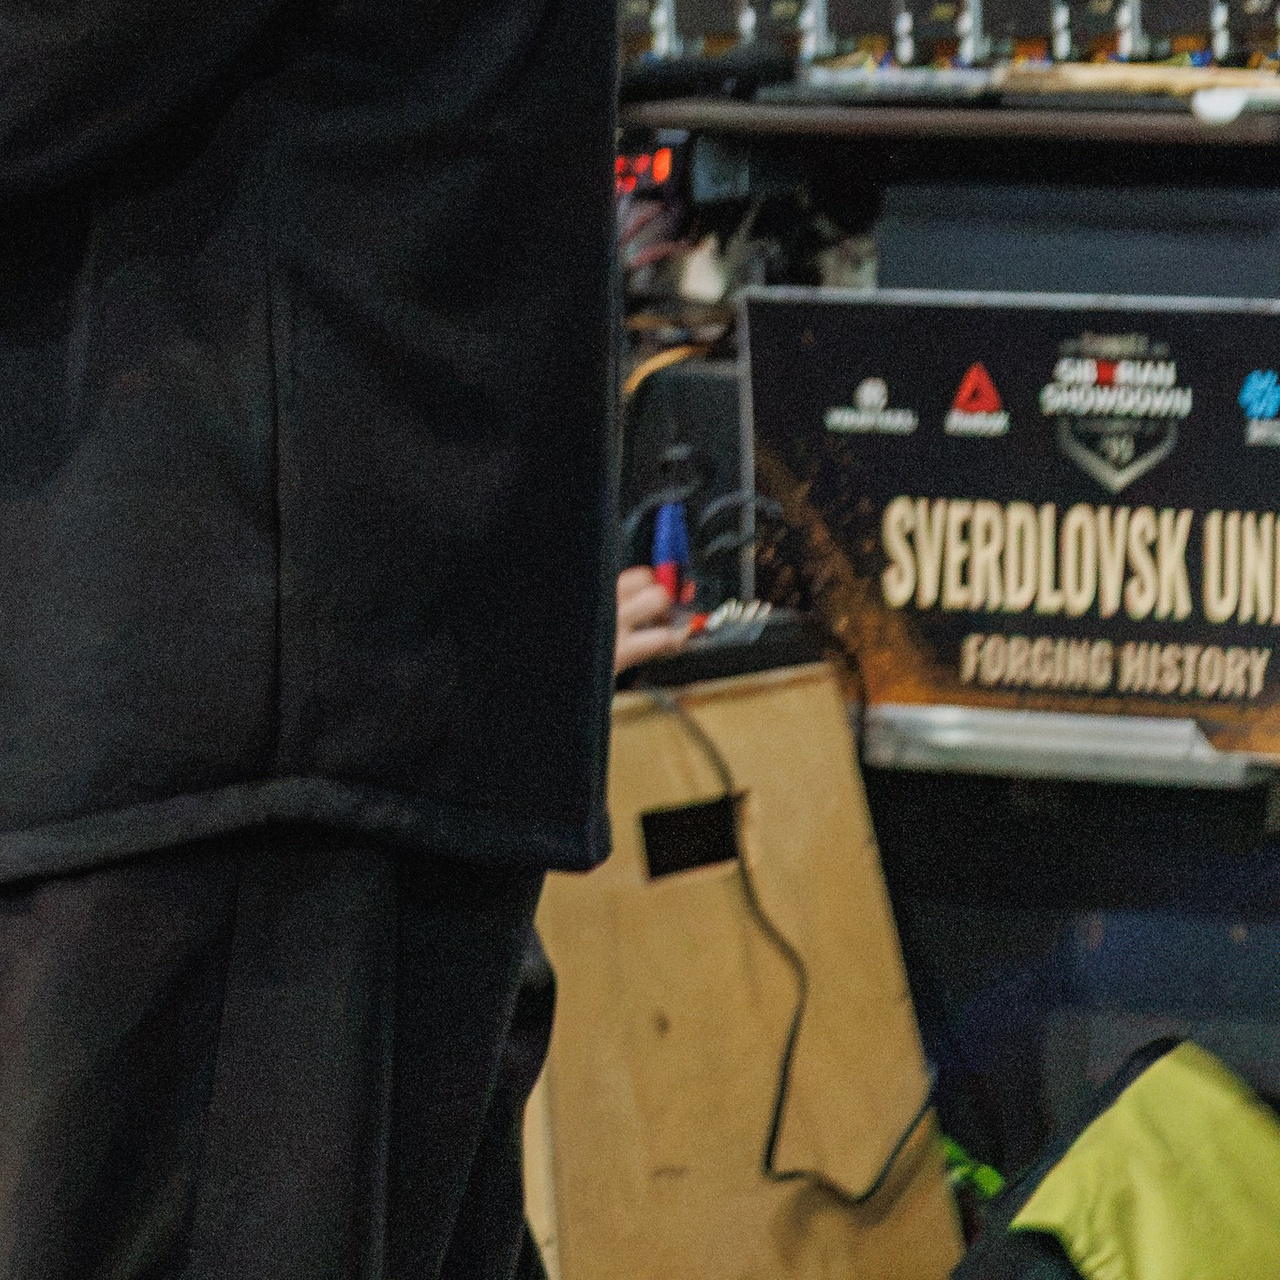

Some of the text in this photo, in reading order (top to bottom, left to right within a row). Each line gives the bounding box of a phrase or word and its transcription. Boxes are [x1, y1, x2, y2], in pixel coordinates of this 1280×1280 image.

[881, 494, 1193, 622] SVERDLOVSK
[961, 633, 1271, 699] FORGING HISTORY
